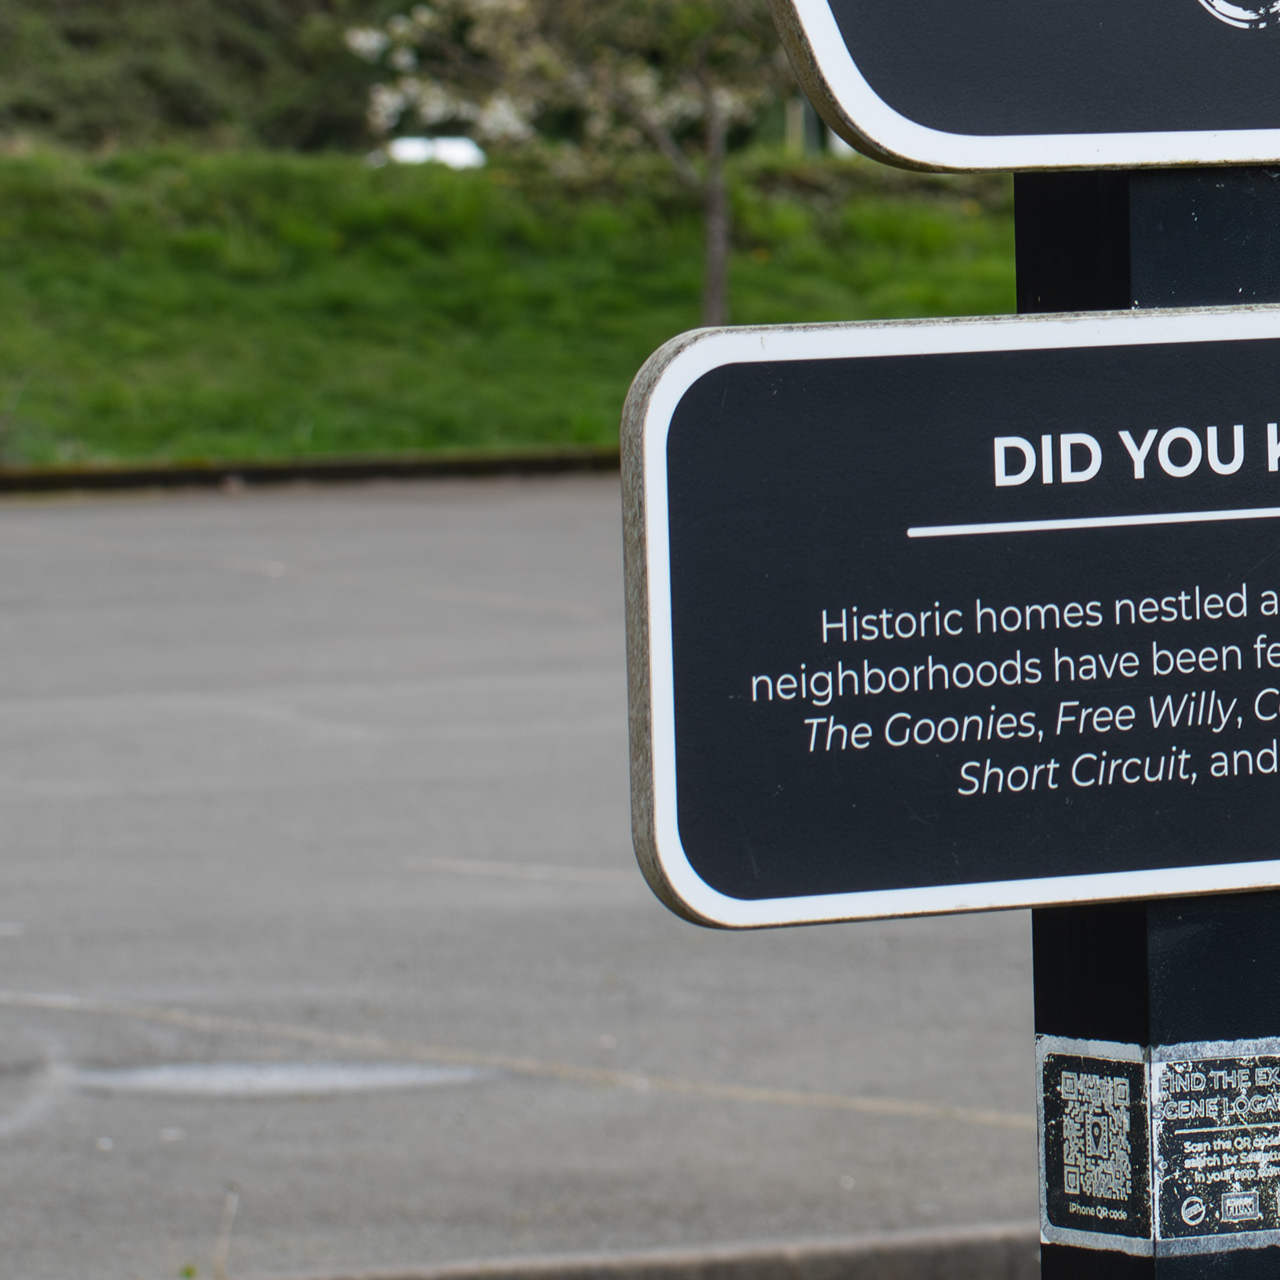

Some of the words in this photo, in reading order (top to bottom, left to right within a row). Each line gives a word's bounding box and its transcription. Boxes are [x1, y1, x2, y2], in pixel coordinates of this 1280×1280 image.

[994, 433, 1102, 486] DID
[1119, 425, 1244, 479] YOU
[823, 602, 962, 642] Historic
[977, 599, 1102, 633] homes
[1116, 583, 1247, 624] nestled
[752, 650, 1041, 706] neighborhoods
[1055, 648, 1139, 681] have
[1153, 641, 1241, 675] been
[805, 716, 872, 751] The
[885, 705, 1043, 746] Goonies,
[1057, 701, 1135, 734] Free
[1150, 690, 1242, 732] Willy,
[958, 759, 1059, 795] Short
[1072, 746, 1196, 786] Circuit,
[1211, 739, 1277, 776] and
[1208, 1069, 1250, 1089] THE
[1152, 1099, 1218, 1120] SCENE
[1233, 1136, 1252, 1151] QR
[1069, 1201, 1095, 1216] iPhone
